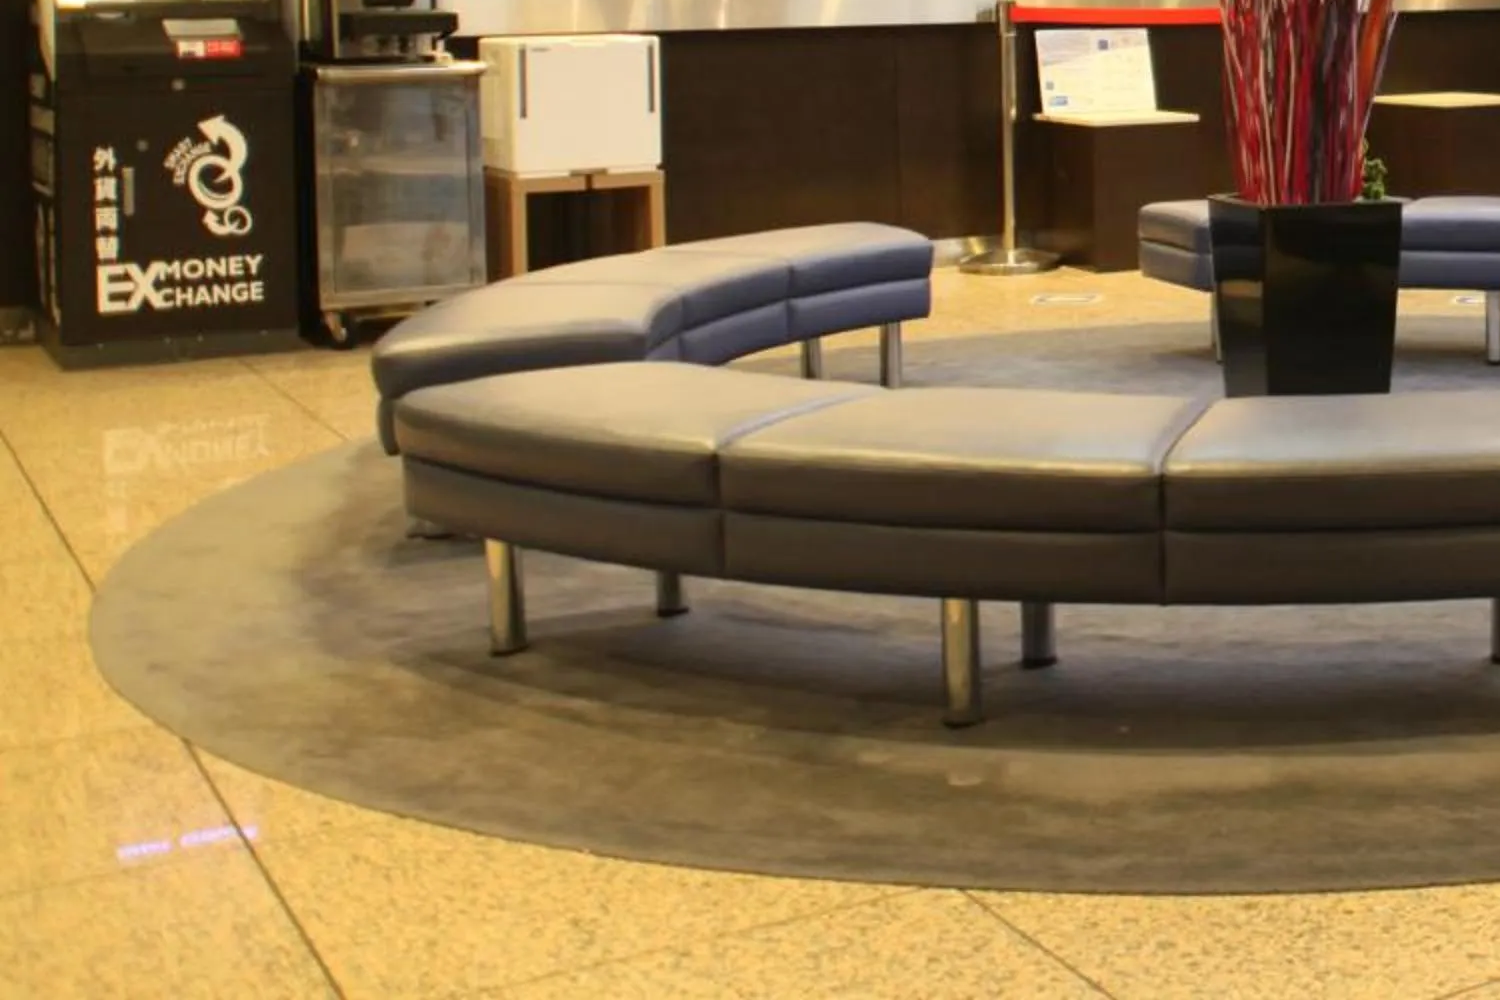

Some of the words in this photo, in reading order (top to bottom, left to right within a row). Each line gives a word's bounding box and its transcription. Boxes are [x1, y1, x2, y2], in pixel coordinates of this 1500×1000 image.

[96, 261, 165, 314] EX
[156, 281, 265, 310] CHANGE
[157, 254, 264, 282] MONEY
